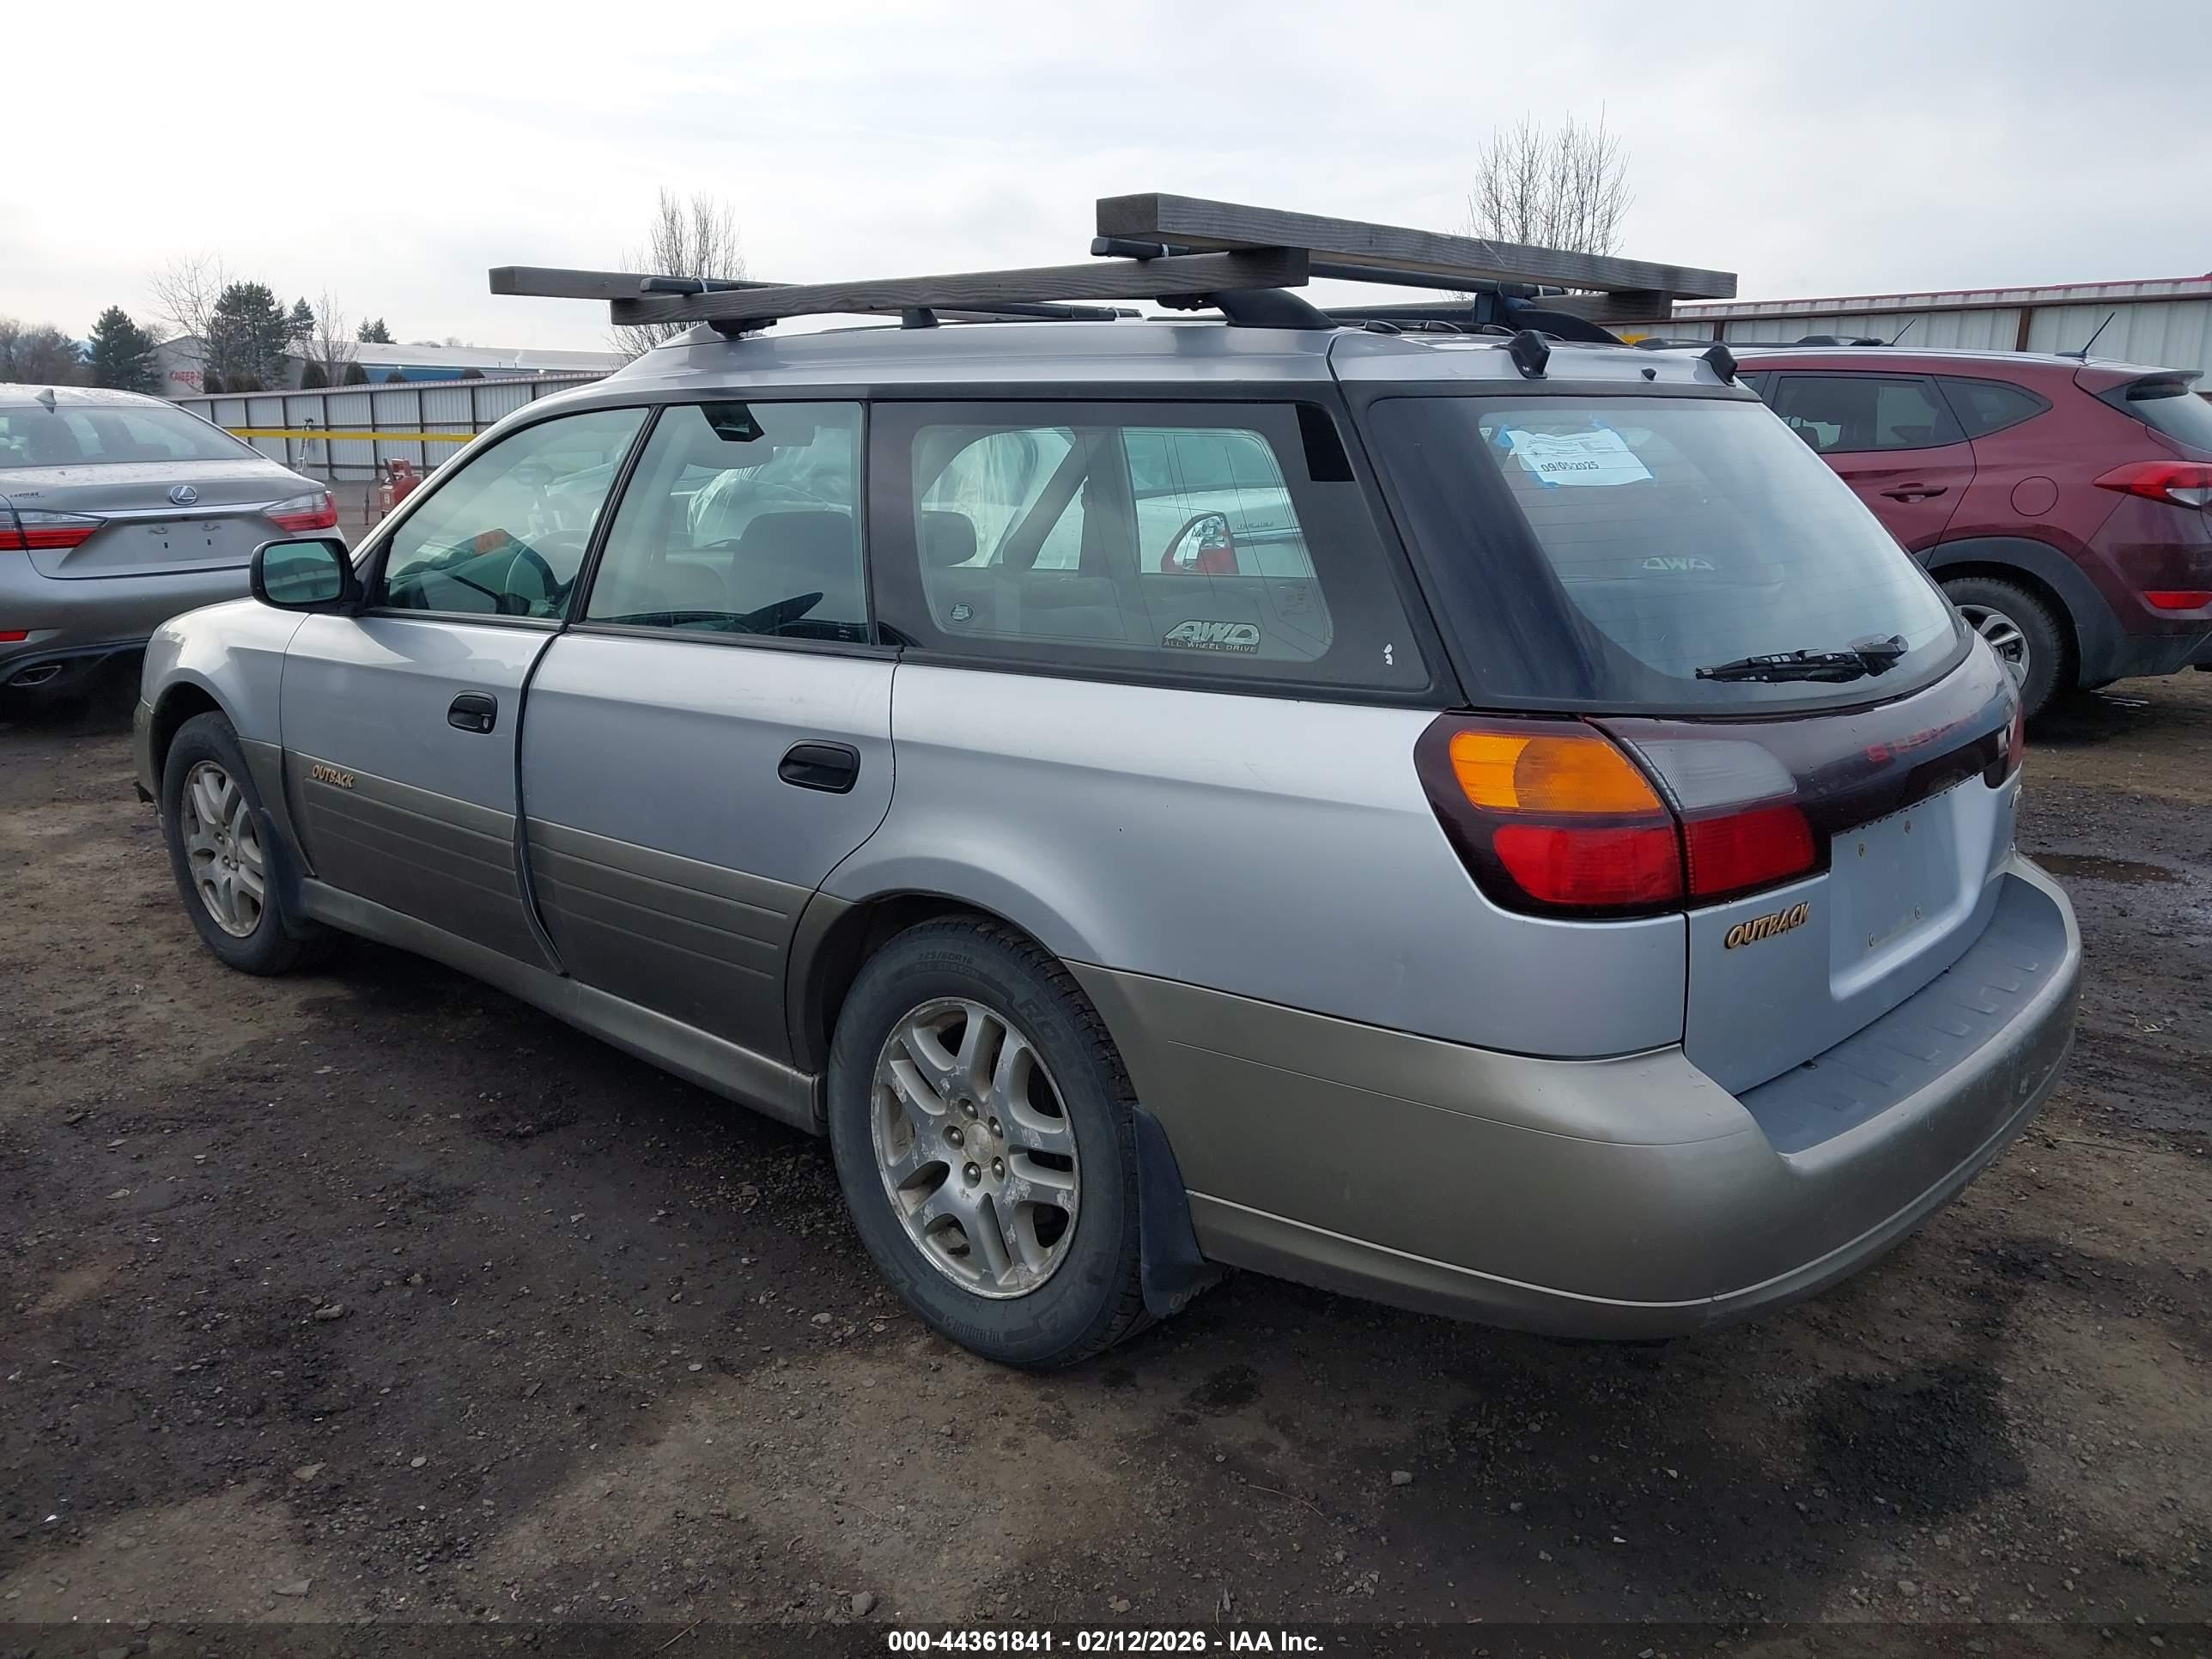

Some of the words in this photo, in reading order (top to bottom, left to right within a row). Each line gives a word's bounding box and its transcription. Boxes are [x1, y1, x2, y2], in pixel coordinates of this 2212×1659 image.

[1164, 620, 1260, 646] AWD
[1187, 641, 1222, 651] WHEEL
[313, 764, 355, 788] OUTBACK
[1724, 902, 1810, 949] OUTBACK
